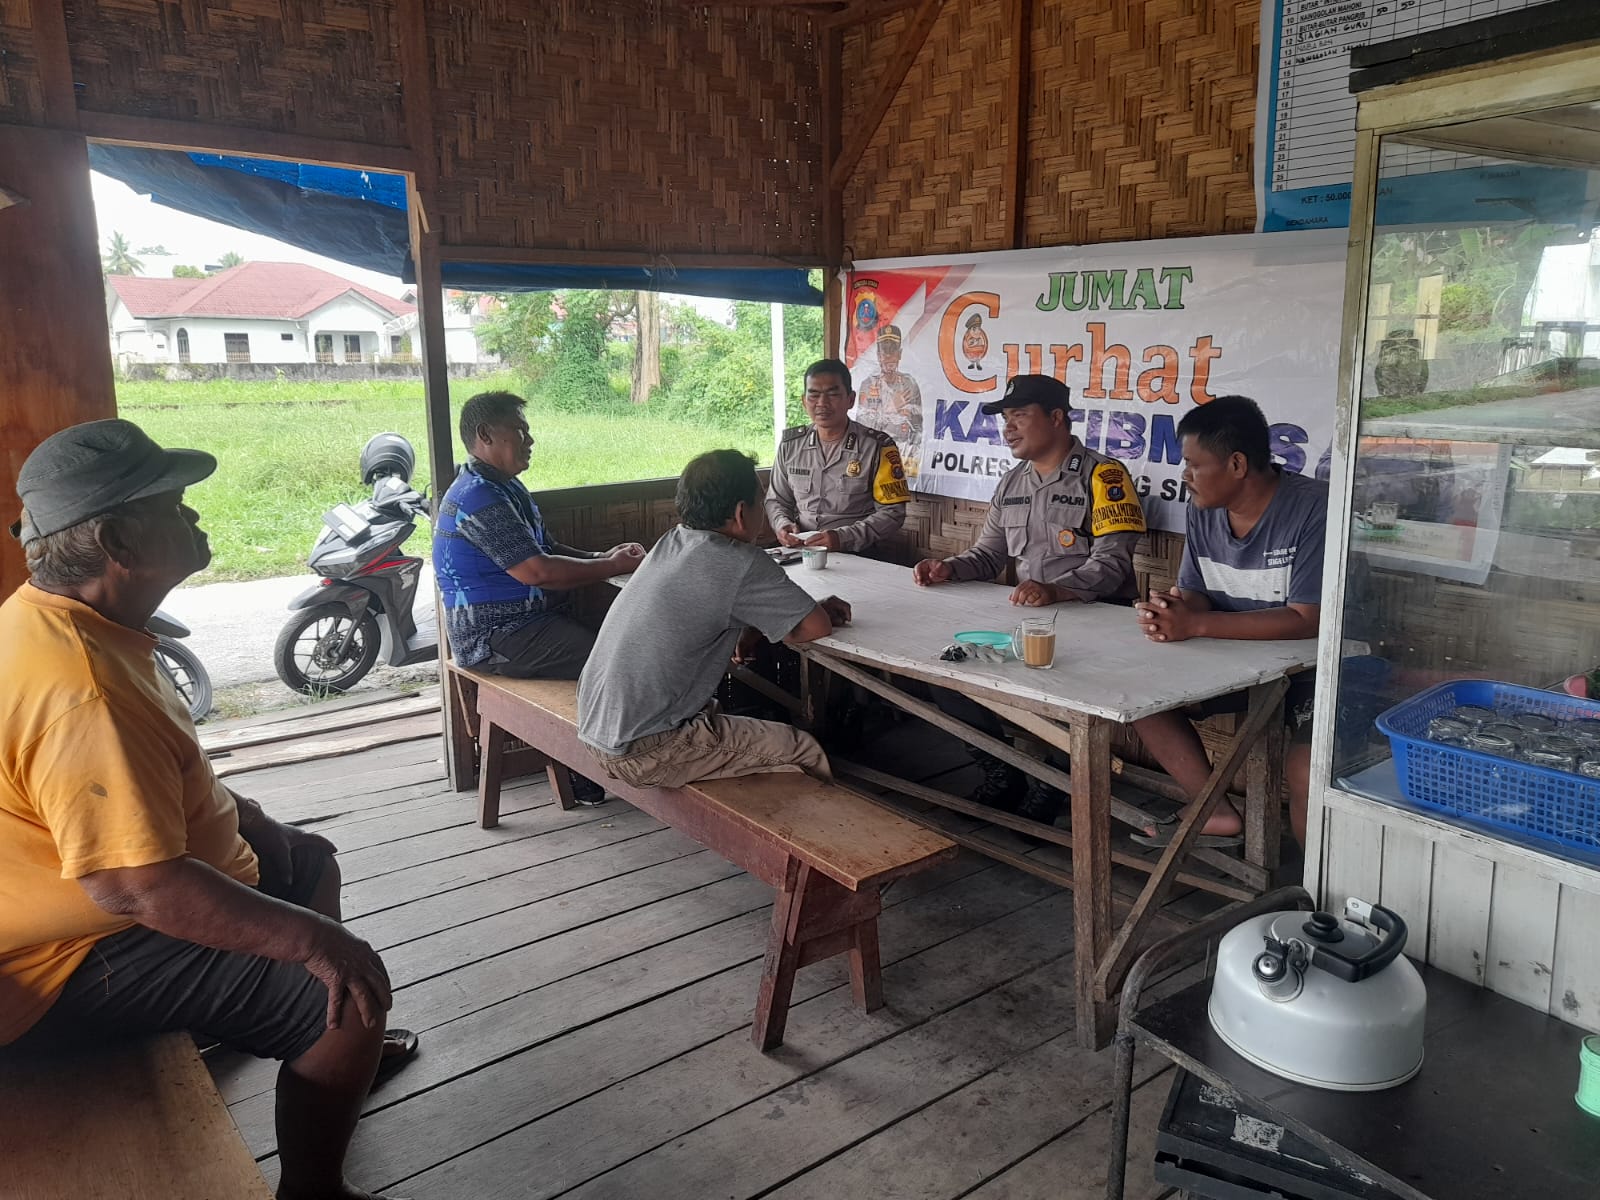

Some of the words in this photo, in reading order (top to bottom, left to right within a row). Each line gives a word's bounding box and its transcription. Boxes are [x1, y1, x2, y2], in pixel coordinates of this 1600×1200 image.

[1343, 21, 1369, 31] GURU
[1279, 122, 1287, 130] 20
[1278, 143, 1286, 151] 22
[1277, 153, 1285, 161] 23
[1276, 183, 1283, 191] 26
[1301, 194, 1318, 205] KET
[1036, 266, 1193, 311] JUMAT
[937, 291, 1222, 405] Curhat
[931, 451, 1011, 478] POLRES
[1051, 493, 1086, 506] POLRI
